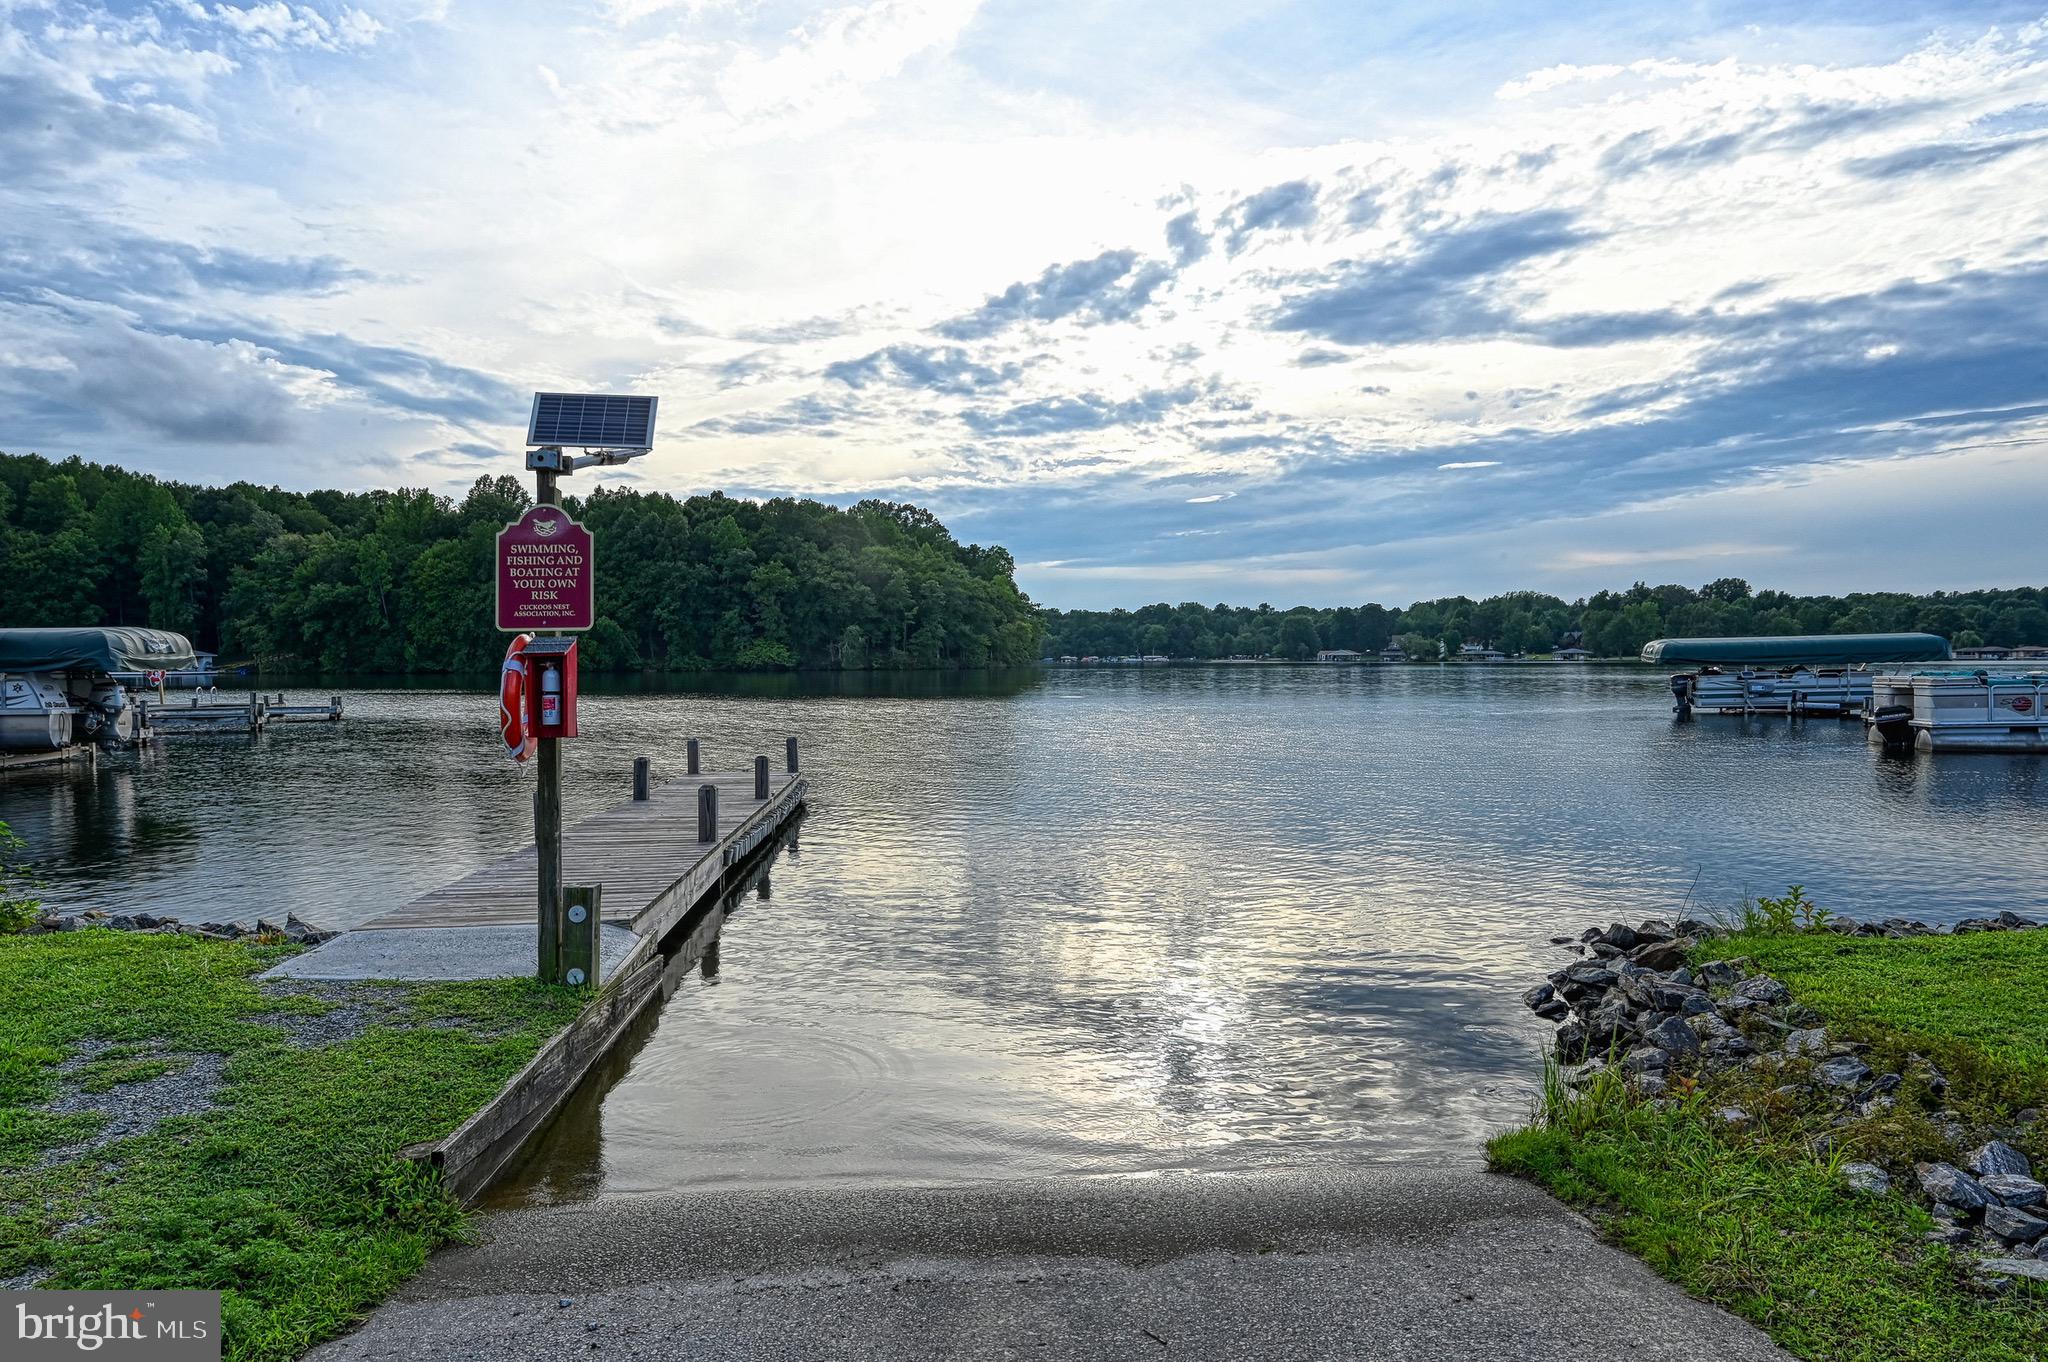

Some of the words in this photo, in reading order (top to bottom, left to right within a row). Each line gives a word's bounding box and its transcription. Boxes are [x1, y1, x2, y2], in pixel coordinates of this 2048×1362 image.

[510, 544, 579, 554] SWIMMING,
[507, 556, 555, 565] FISHING
[557, 556, 583, 565] AND
[510, 568, 563, 577] BOATING
[565, 568, 580, 577] AT
[513, 579, 545, 589] YOUR
[548, 579, 577, 588] OWN
[531, 591, 558, 600] RISK
